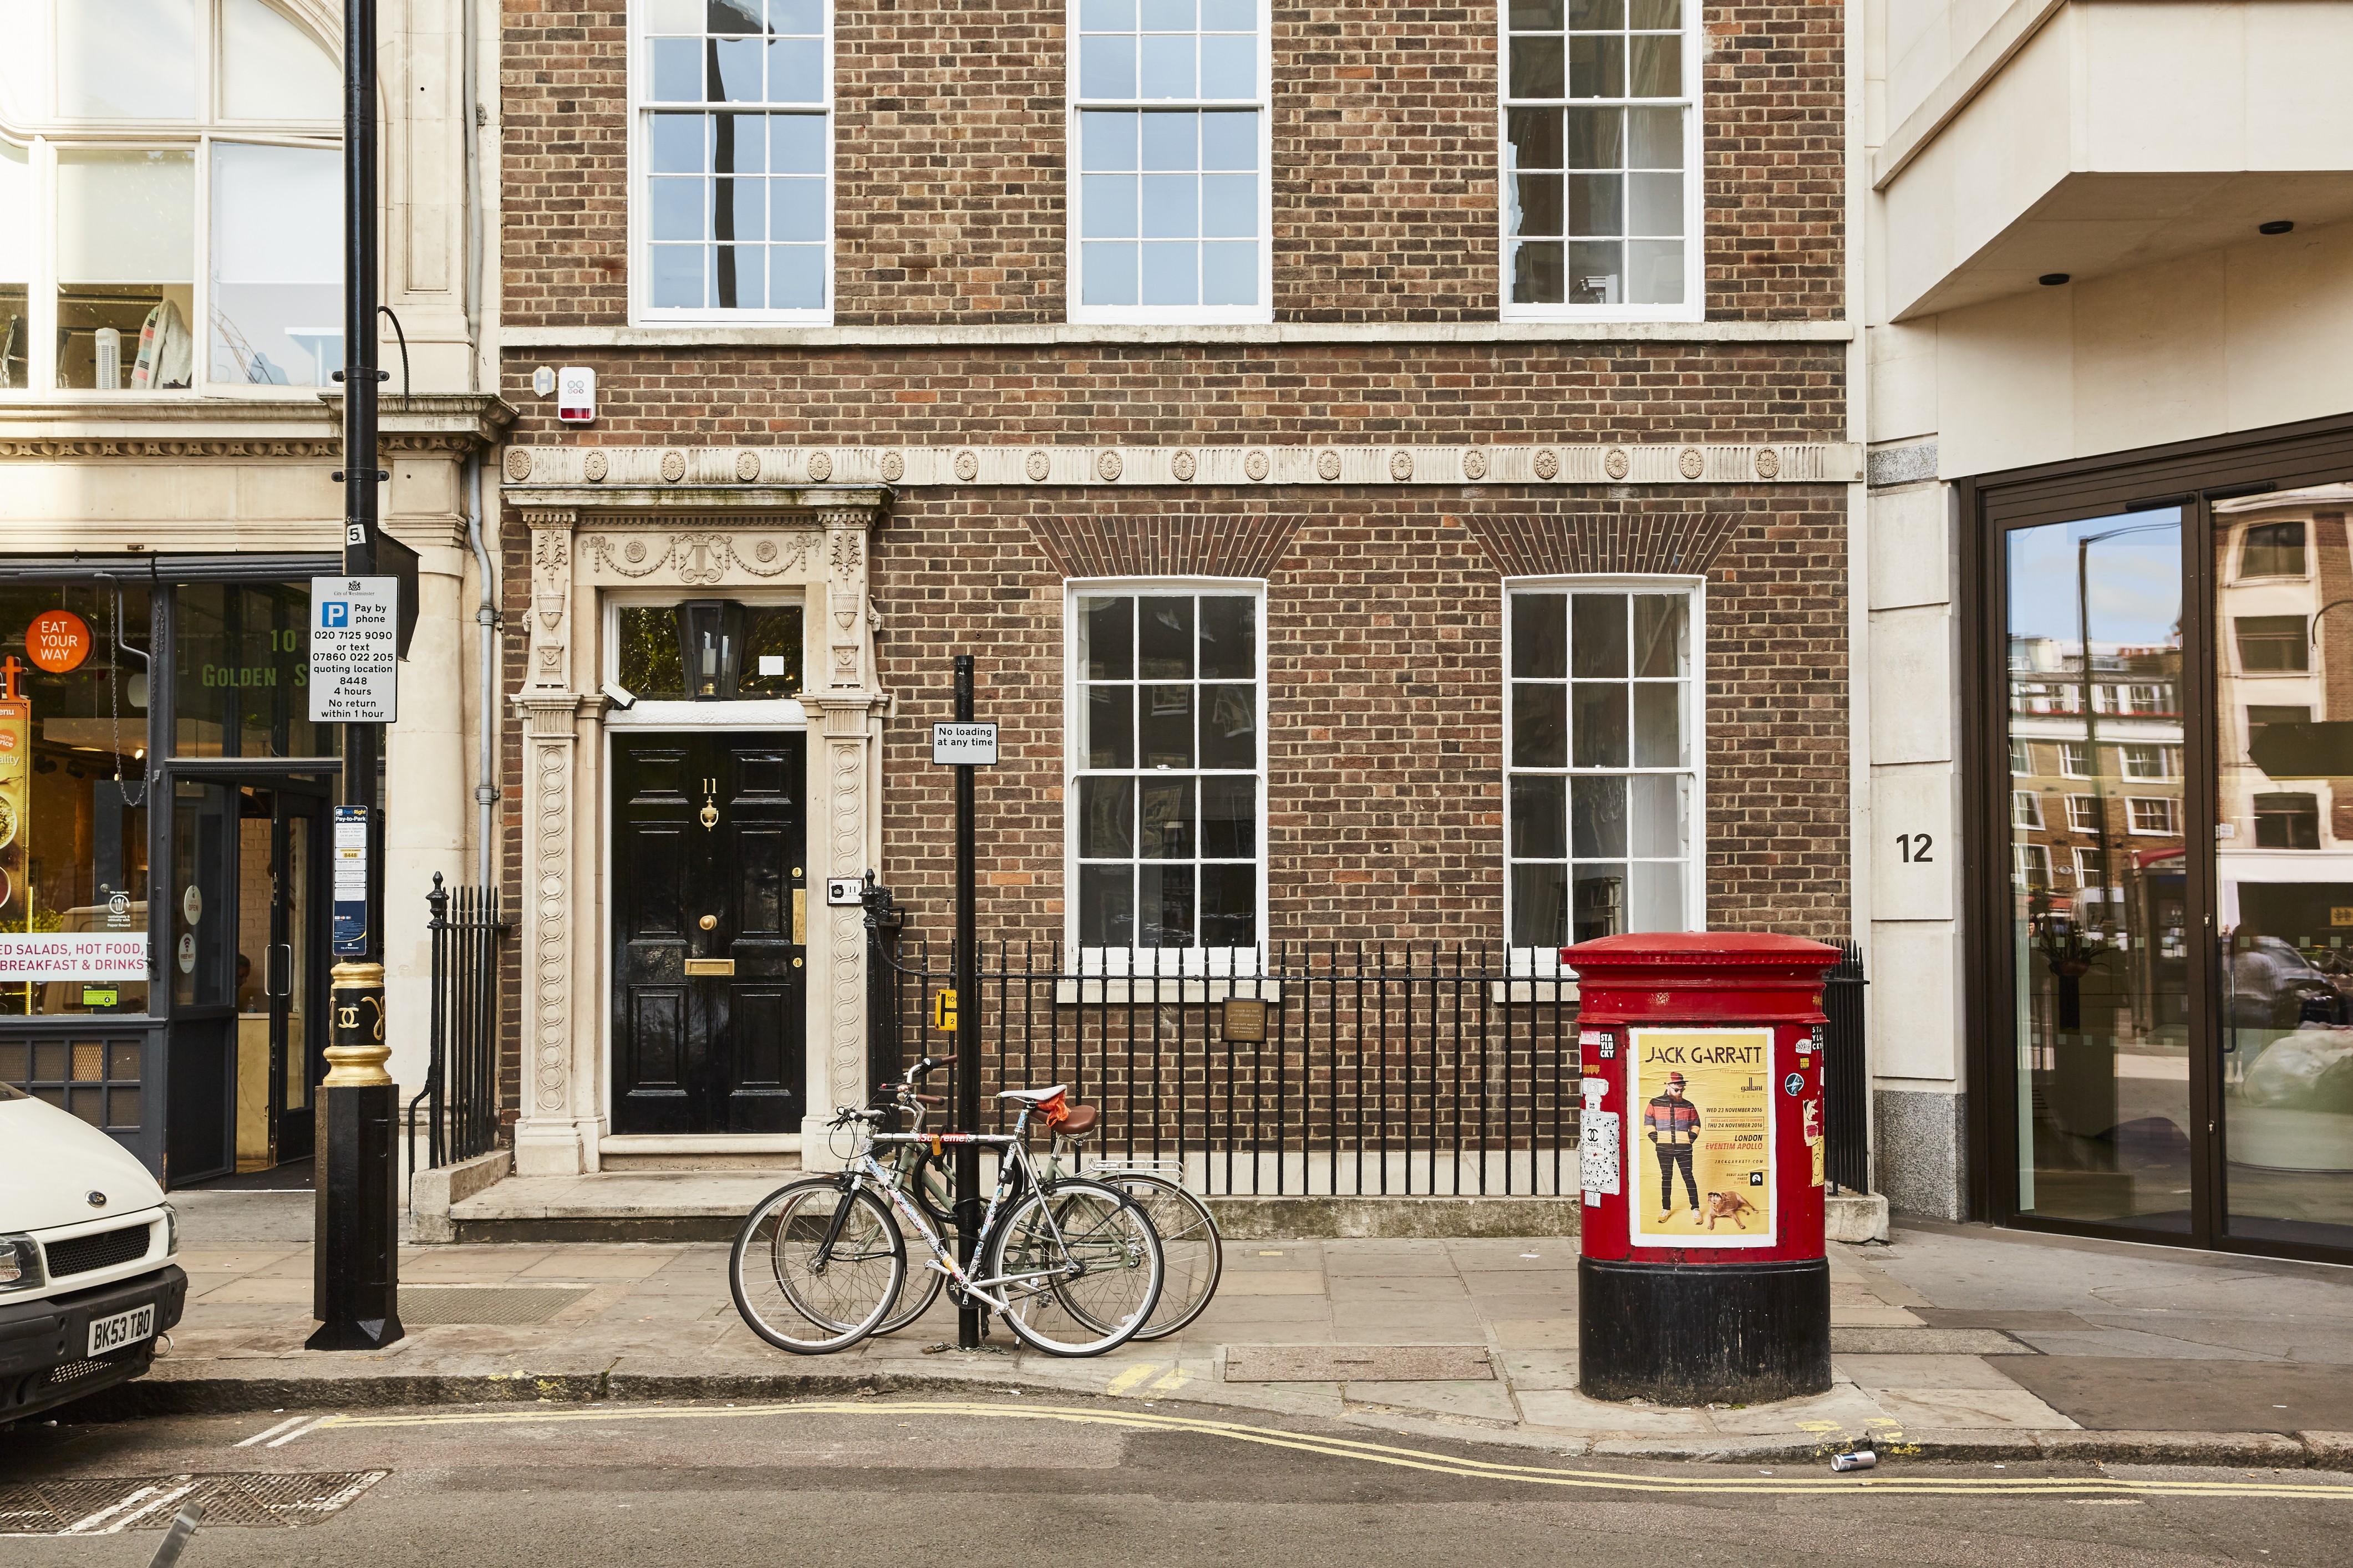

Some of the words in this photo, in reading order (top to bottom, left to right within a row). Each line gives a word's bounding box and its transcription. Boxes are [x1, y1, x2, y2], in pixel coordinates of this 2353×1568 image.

[536, 372, 552, 391] H
[350, 528, 359, 541] 5
[328, 605, 344, 625] P
[354, 604, 372, 613] Pay
[375, 604, 387, 613] by
[356, 615, 385, 624] phone
[42, 622, 67, 633] EAT
[41, 635, 77, 647] YOUR
[270, 629, 296, 652] 10
[314, 631, 335, 639] 020
[339, 631, 361, 639] 7125
[365, 631, 392, 639] 9090
[41, 649, 69, 660] WAY
[314, 665, 351, 674] quoting
[957, 727, 992, 737] loading
[703, 778, 716, 793] 11
[1897, 834, 1933, 862] 12
[17, 944, 72, 956] SALADS,
[76, 944, 101, 954] HOT
[106, 943, 144, 955] FOOD,
[1, 959, 78, 971] BREAKFAST
[82, 959, 90, 970] &
[95, 959, 144, 970] DRINKS
[1645, 1047, 1686, 1063] JACK
[1691, 1047, 1761, 1063] GARRATT
[1741, 1077, 1762, 1092] gallant
[94, 1316, 126, 1350] BK53
